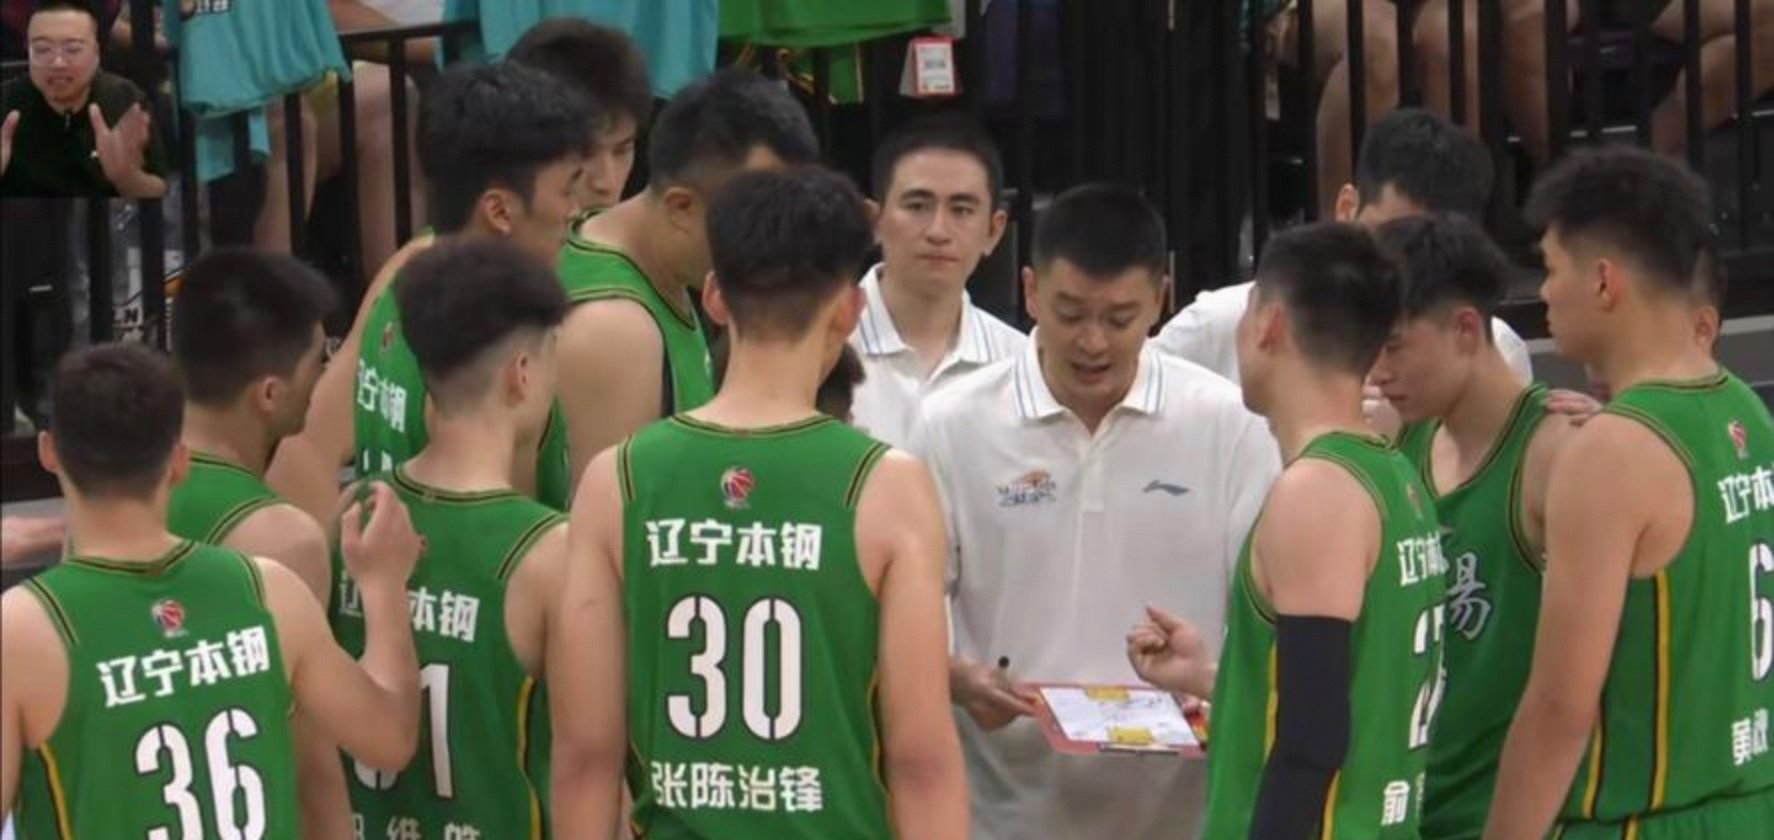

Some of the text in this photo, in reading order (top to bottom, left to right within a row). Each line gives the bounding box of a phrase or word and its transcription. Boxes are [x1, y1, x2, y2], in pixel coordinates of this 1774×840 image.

[1717, 464, 1774, 522] 辽宁本
[646, 518, 822, 570] 辽宁本钢
[96, 625, 270, 708] 辽宁本钢
[667, 596, 801, 740] 30
[135, 708, 266, 840] 36
[651, 761, 822, 812] 张陈治锋
